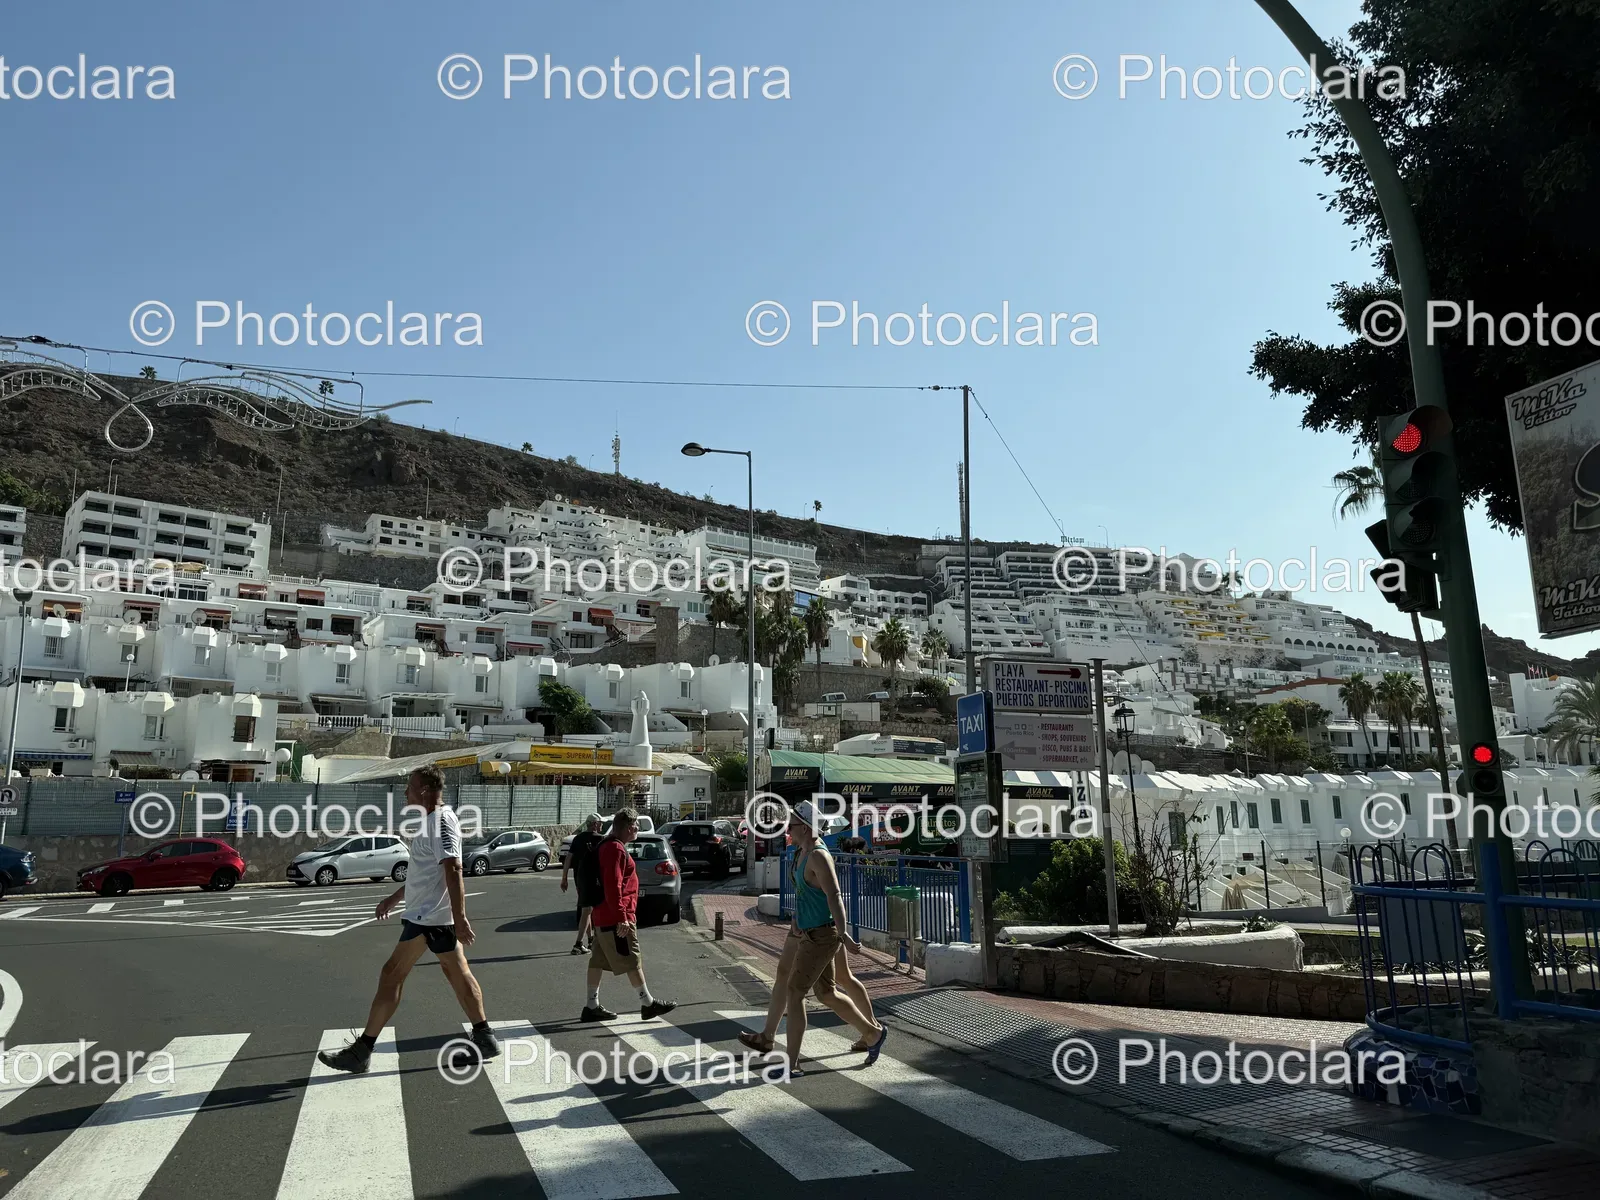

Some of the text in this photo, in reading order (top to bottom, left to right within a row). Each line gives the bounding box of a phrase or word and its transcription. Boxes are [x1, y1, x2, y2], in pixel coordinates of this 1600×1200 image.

[995, 663, 1025, 677] PLAYA
[996, 693, 1089, 709] PUERTOS DEPORTIVOS
[960, 713, 984, 735] TAXI
[1041, 723, 1074, 732] RESTAURANTS
[1060, 735, 1087, 743] SOUVENIRS
[566, 752, 611, 761] SUPERMRKET
[784, 768, 809, 777] AVANT
[842, 784, 873, 793] AVANT
[891, 785, 921, 793] AVANT
[1027, 787, 1053, 795] AVANT
